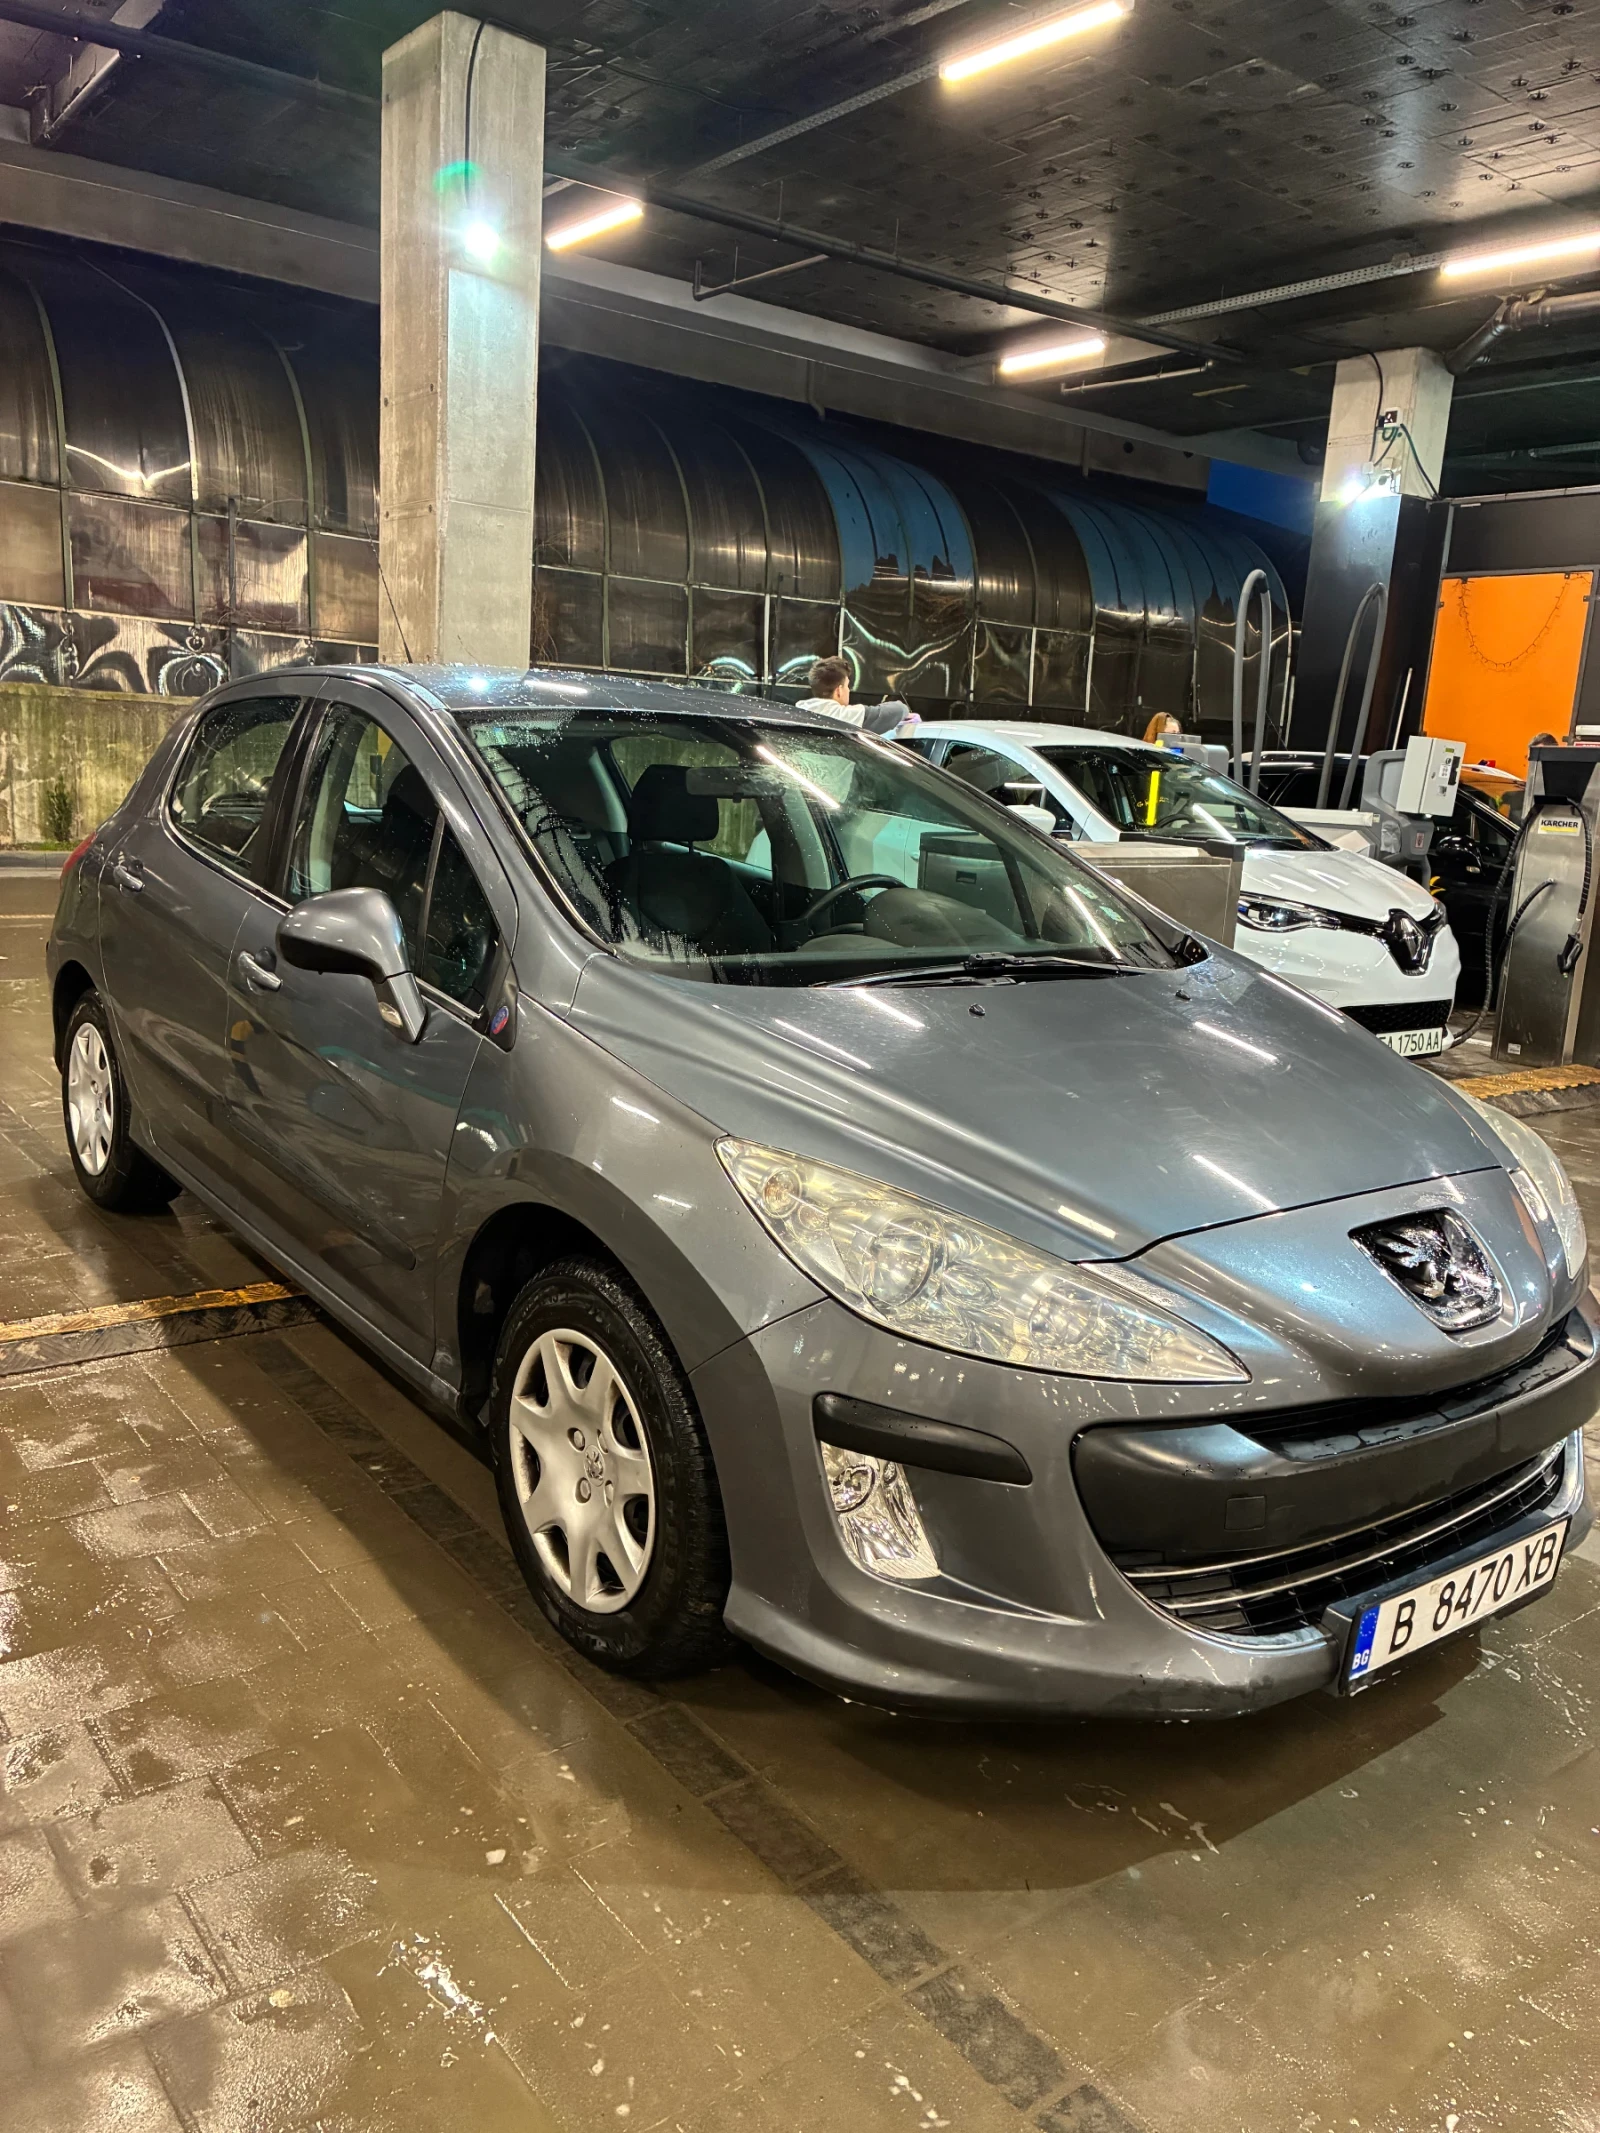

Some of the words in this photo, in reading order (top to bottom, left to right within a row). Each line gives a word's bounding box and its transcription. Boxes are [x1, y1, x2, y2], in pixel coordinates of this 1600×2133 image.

[1379, 1035, 1393, 1049] A
[1398, 1032, 1425, 1054] 1750
[1425, 1031, 1439, 1051] AA
[1389, 1598, 1416, 1655] B
[1432, 1553, 1513, 1632] 8470
[1515, 1531, 1558, 1593] XB
[1352, 1649, 1370, 1670] BG
